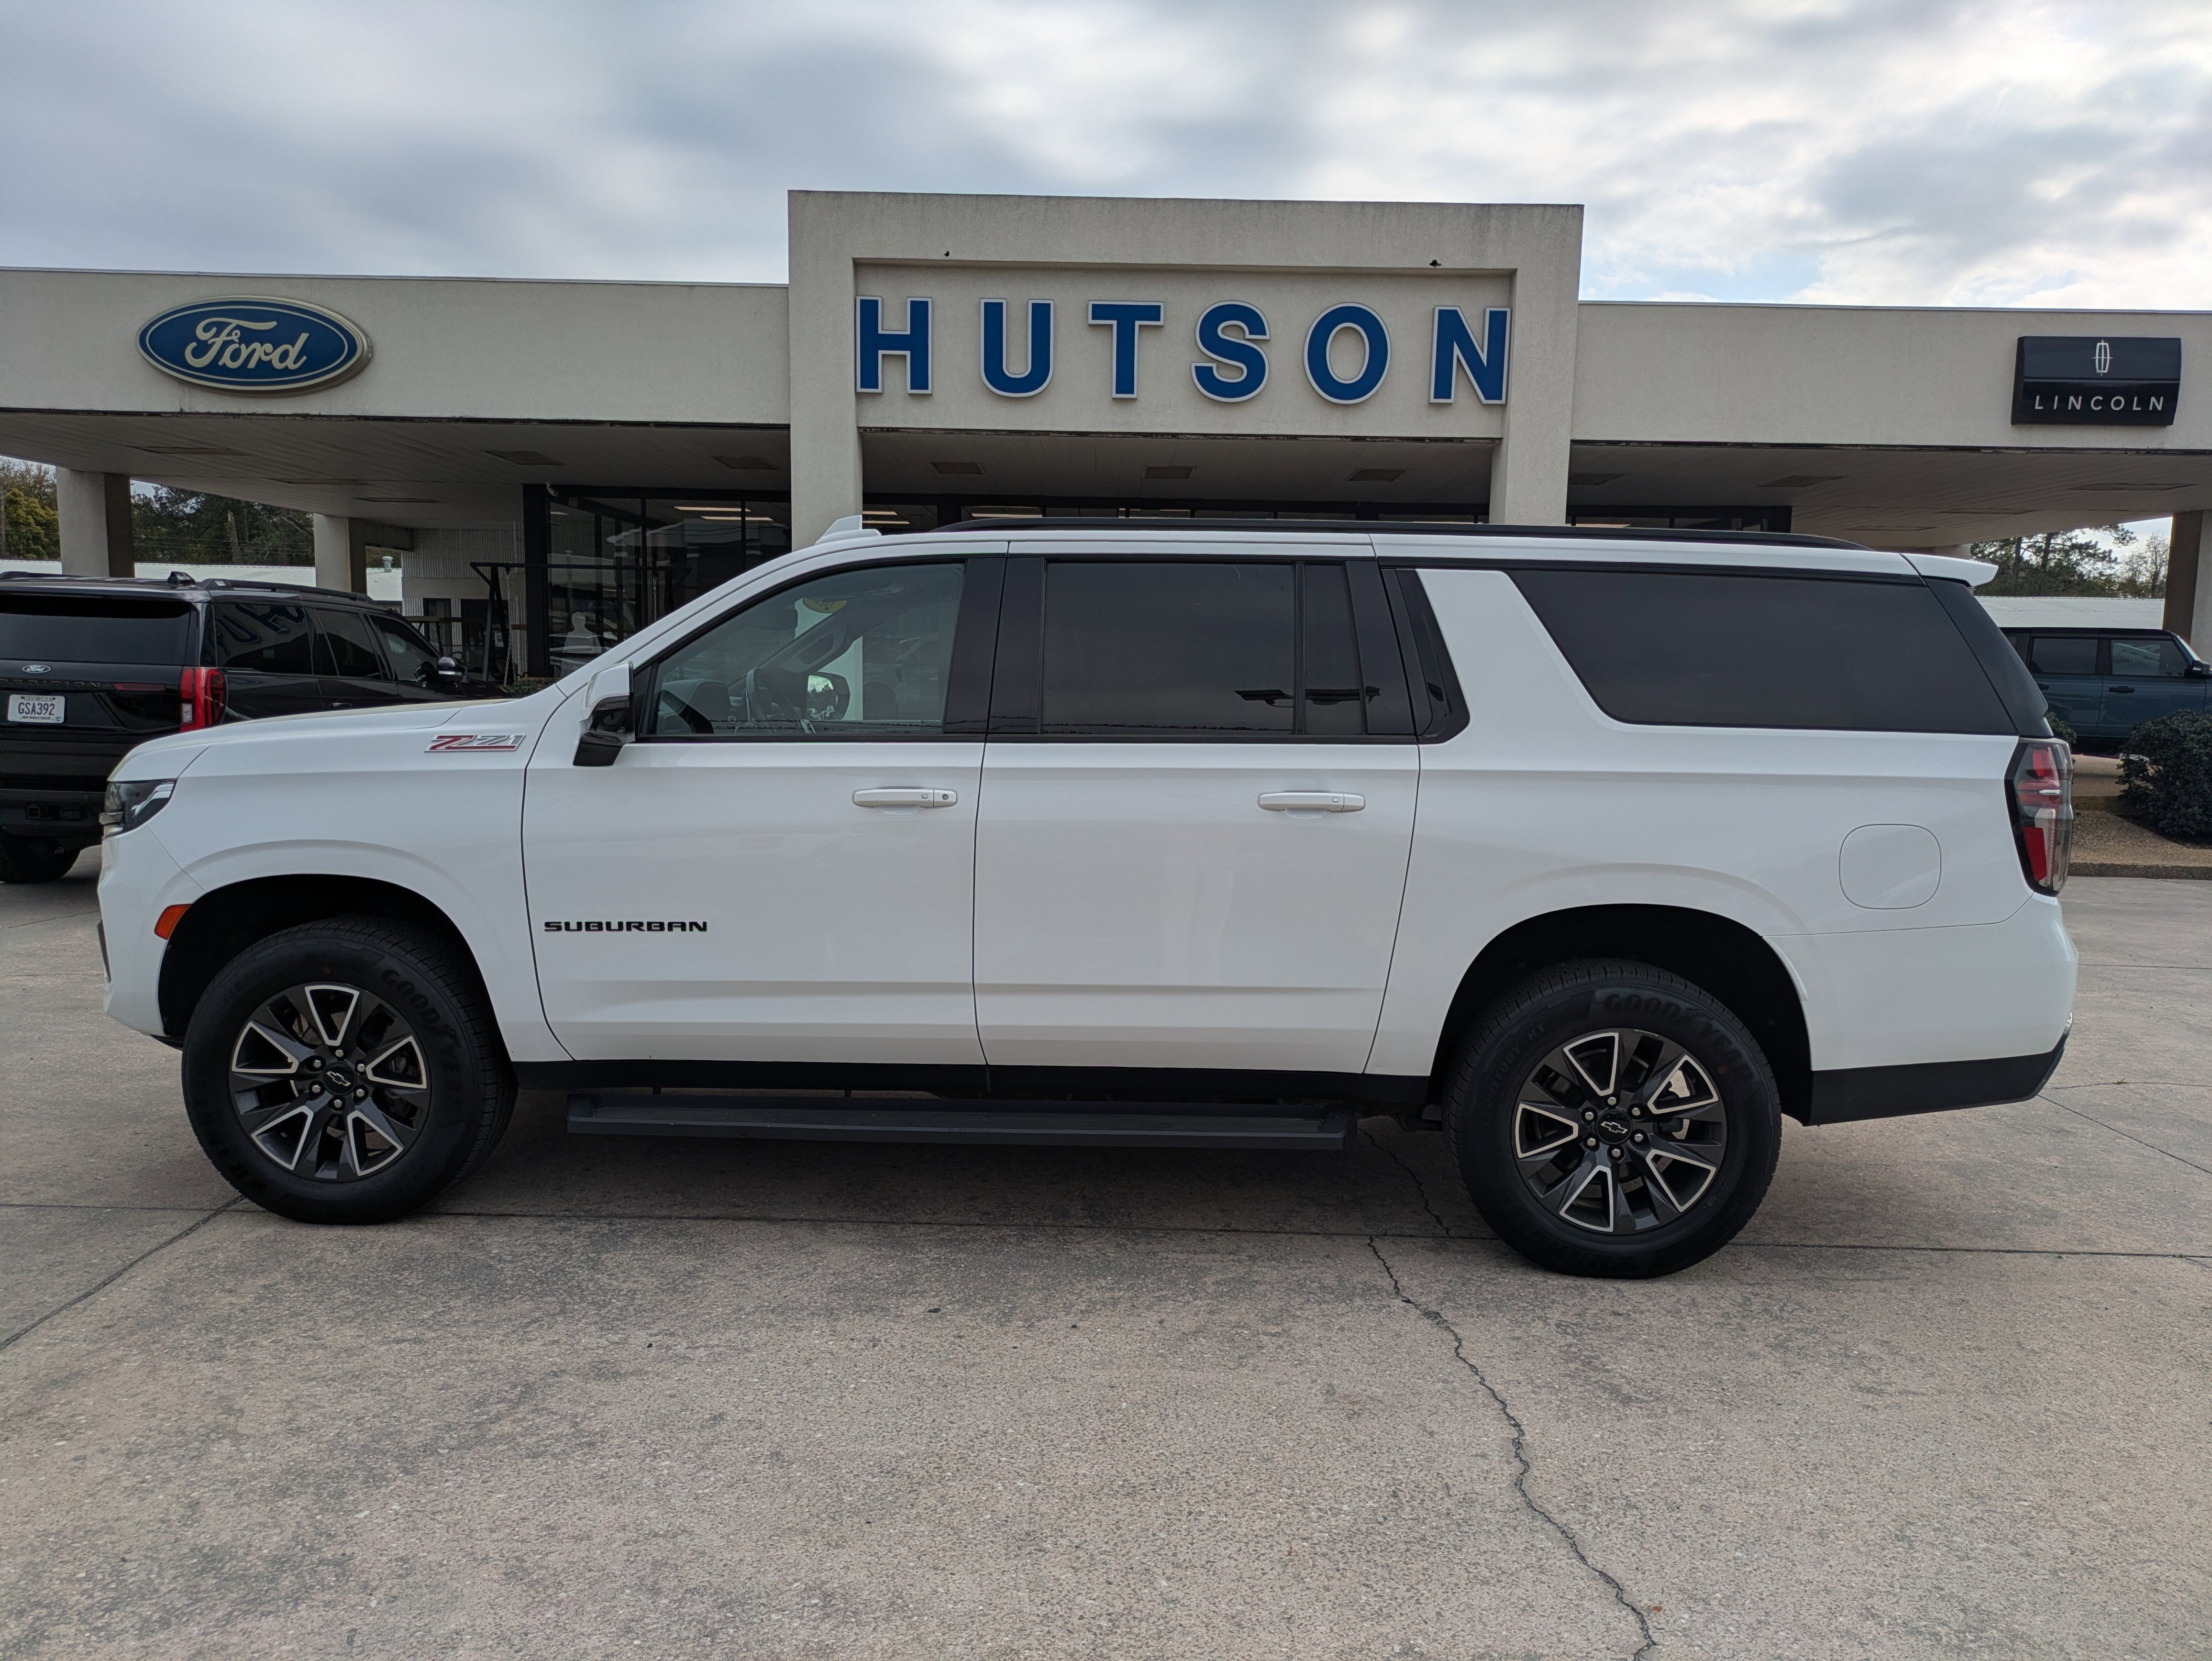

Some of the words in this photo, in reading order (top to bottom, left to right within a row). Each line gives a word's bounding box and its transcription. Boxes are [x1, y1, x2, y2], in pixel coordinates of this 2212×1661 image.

[185, 318, 309, 370] Ford
[856, 296, 1512, 404] HUTSON
[2035, 396, 2163, 410] LINCOLN
[18, 702, 55, 716] GSA392
[424, 734, 526, 753] Z71
[544, 921, 707, 931] SUBURBAN
[1482, 1043, 1520, 1128] RRITORY
